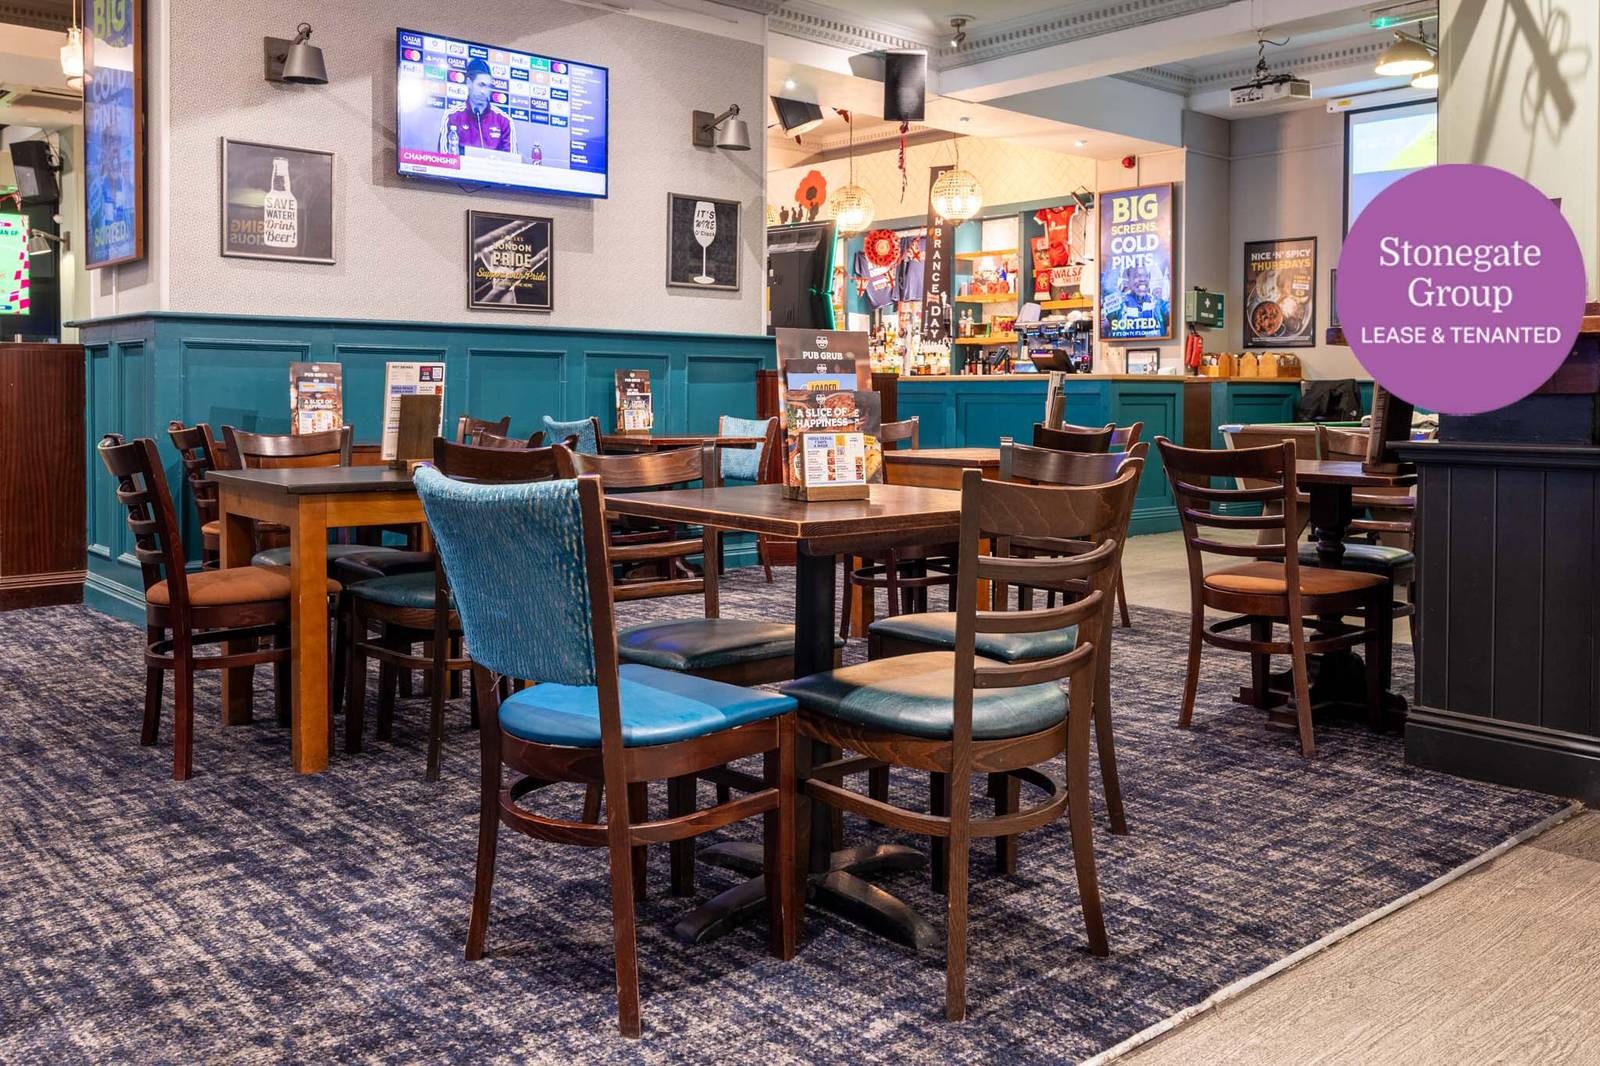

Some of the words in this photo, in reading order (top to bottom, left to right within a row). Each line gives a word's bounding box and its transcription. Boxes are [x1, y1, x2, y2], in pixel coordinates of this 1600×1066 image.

[93, 0, 126, 39] BIG
[93, 69, 128, 103] COLD
[403, 152, 458, 165] CHAMPIONSHIP
[266, 197, 295, 210] SAVE
[1111, 193, 1159, 223] BIG
[266, 209, 295, 220] WATER!
[696, 210, 715, 219] IT'S
[265, 220, 295, 231] Drink
[265, 230, 296, 243] Beer!
[493, 242, 532, 253] LONDON
[1111, 234, 1159, 254] COLD
[491, 251, 532, 268] PRIDE
[1251, 252, 1271, 260] NICE
[1286, 249, 1311, 258] SPICY
[1251, 258, 1313, 271] THURSDAYS
[802, 351, 820, 360] PUB
[820, 351, 843, 360] GRUB
[796, 409, 804, 418] A
[805, 408, 832, 417] SLICE
[833, 408, 848, 416] OF
[796, 418, 848, 428] HAPPINESS
